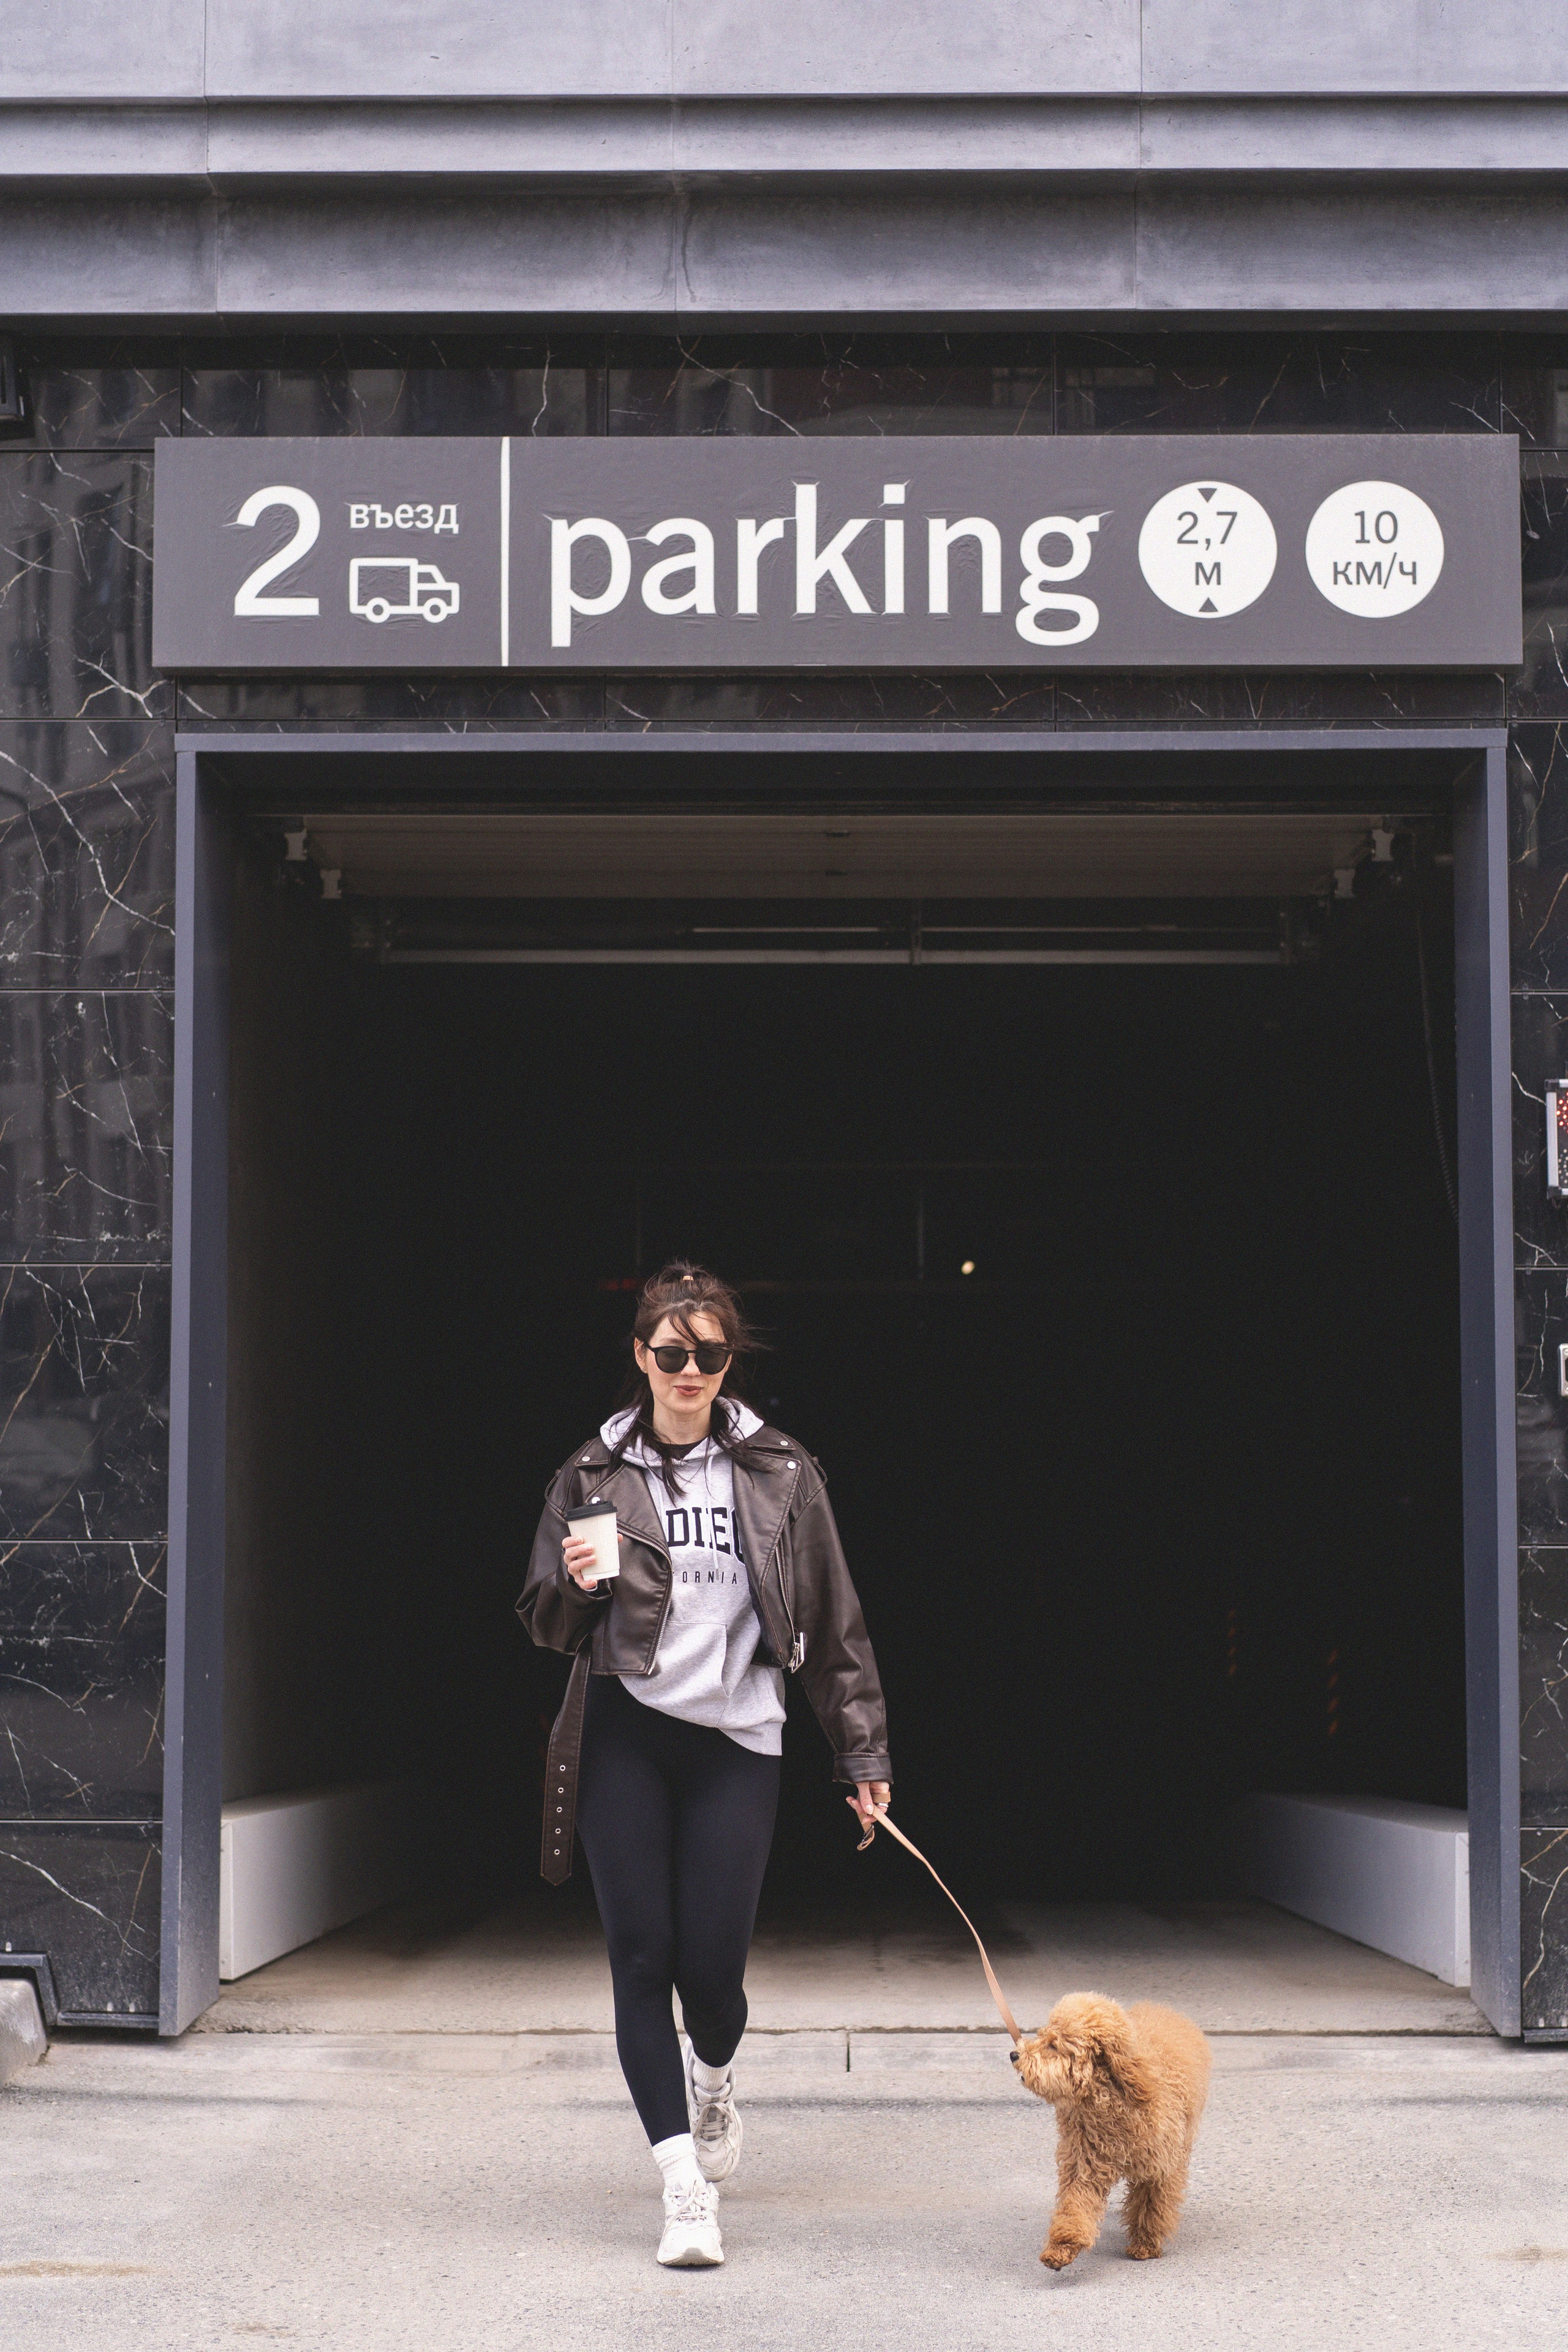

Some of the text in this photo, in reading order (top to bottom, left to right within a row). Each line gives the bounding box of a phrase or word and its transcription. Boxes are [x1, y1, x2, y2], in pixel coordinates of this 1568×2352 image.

[348, 503, 459, 535] въезд
[1177, 511, 1238, 551] 2,7
[1354, 510, 1398, 545] 10
[233, 484, 321, 617] 2
[550, 483, 1101, 647] parking
